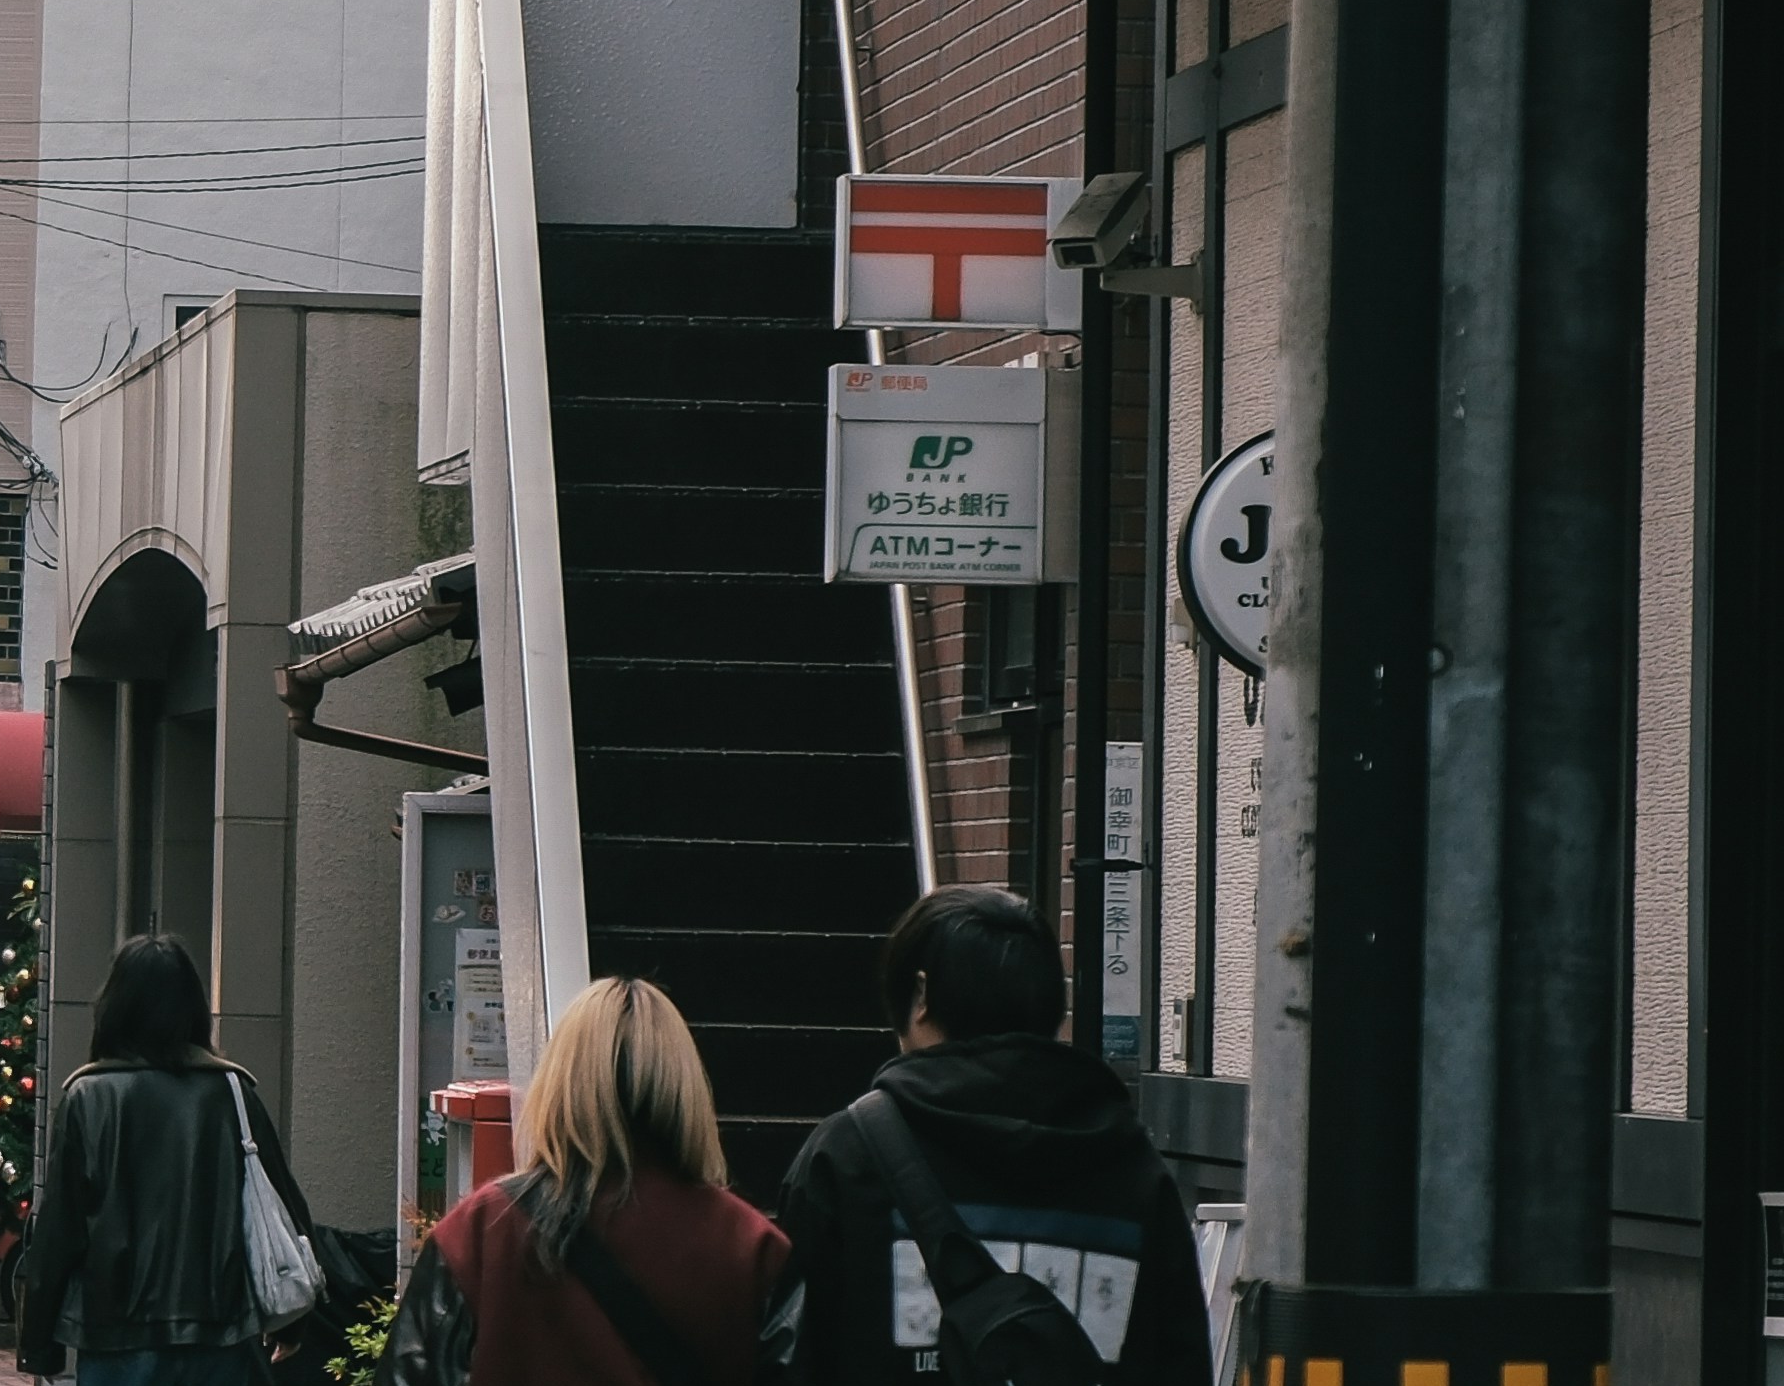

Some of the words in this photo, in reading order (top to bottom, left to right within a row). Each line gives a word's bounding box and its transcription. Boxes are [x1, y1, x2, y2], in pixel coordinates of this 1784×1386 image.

[880, 376, 928, 391] 郵便局
[909, 436, 973, 469] JP
[906, 473, 967, 483] BANK
[868, 491, 1009, 517] ゆうちょ銀行
[870, 536, 1022, 557] ATMコーナー
[903, 562, 926, 570] POST
[983, 564, 1021, 572] CORNER
